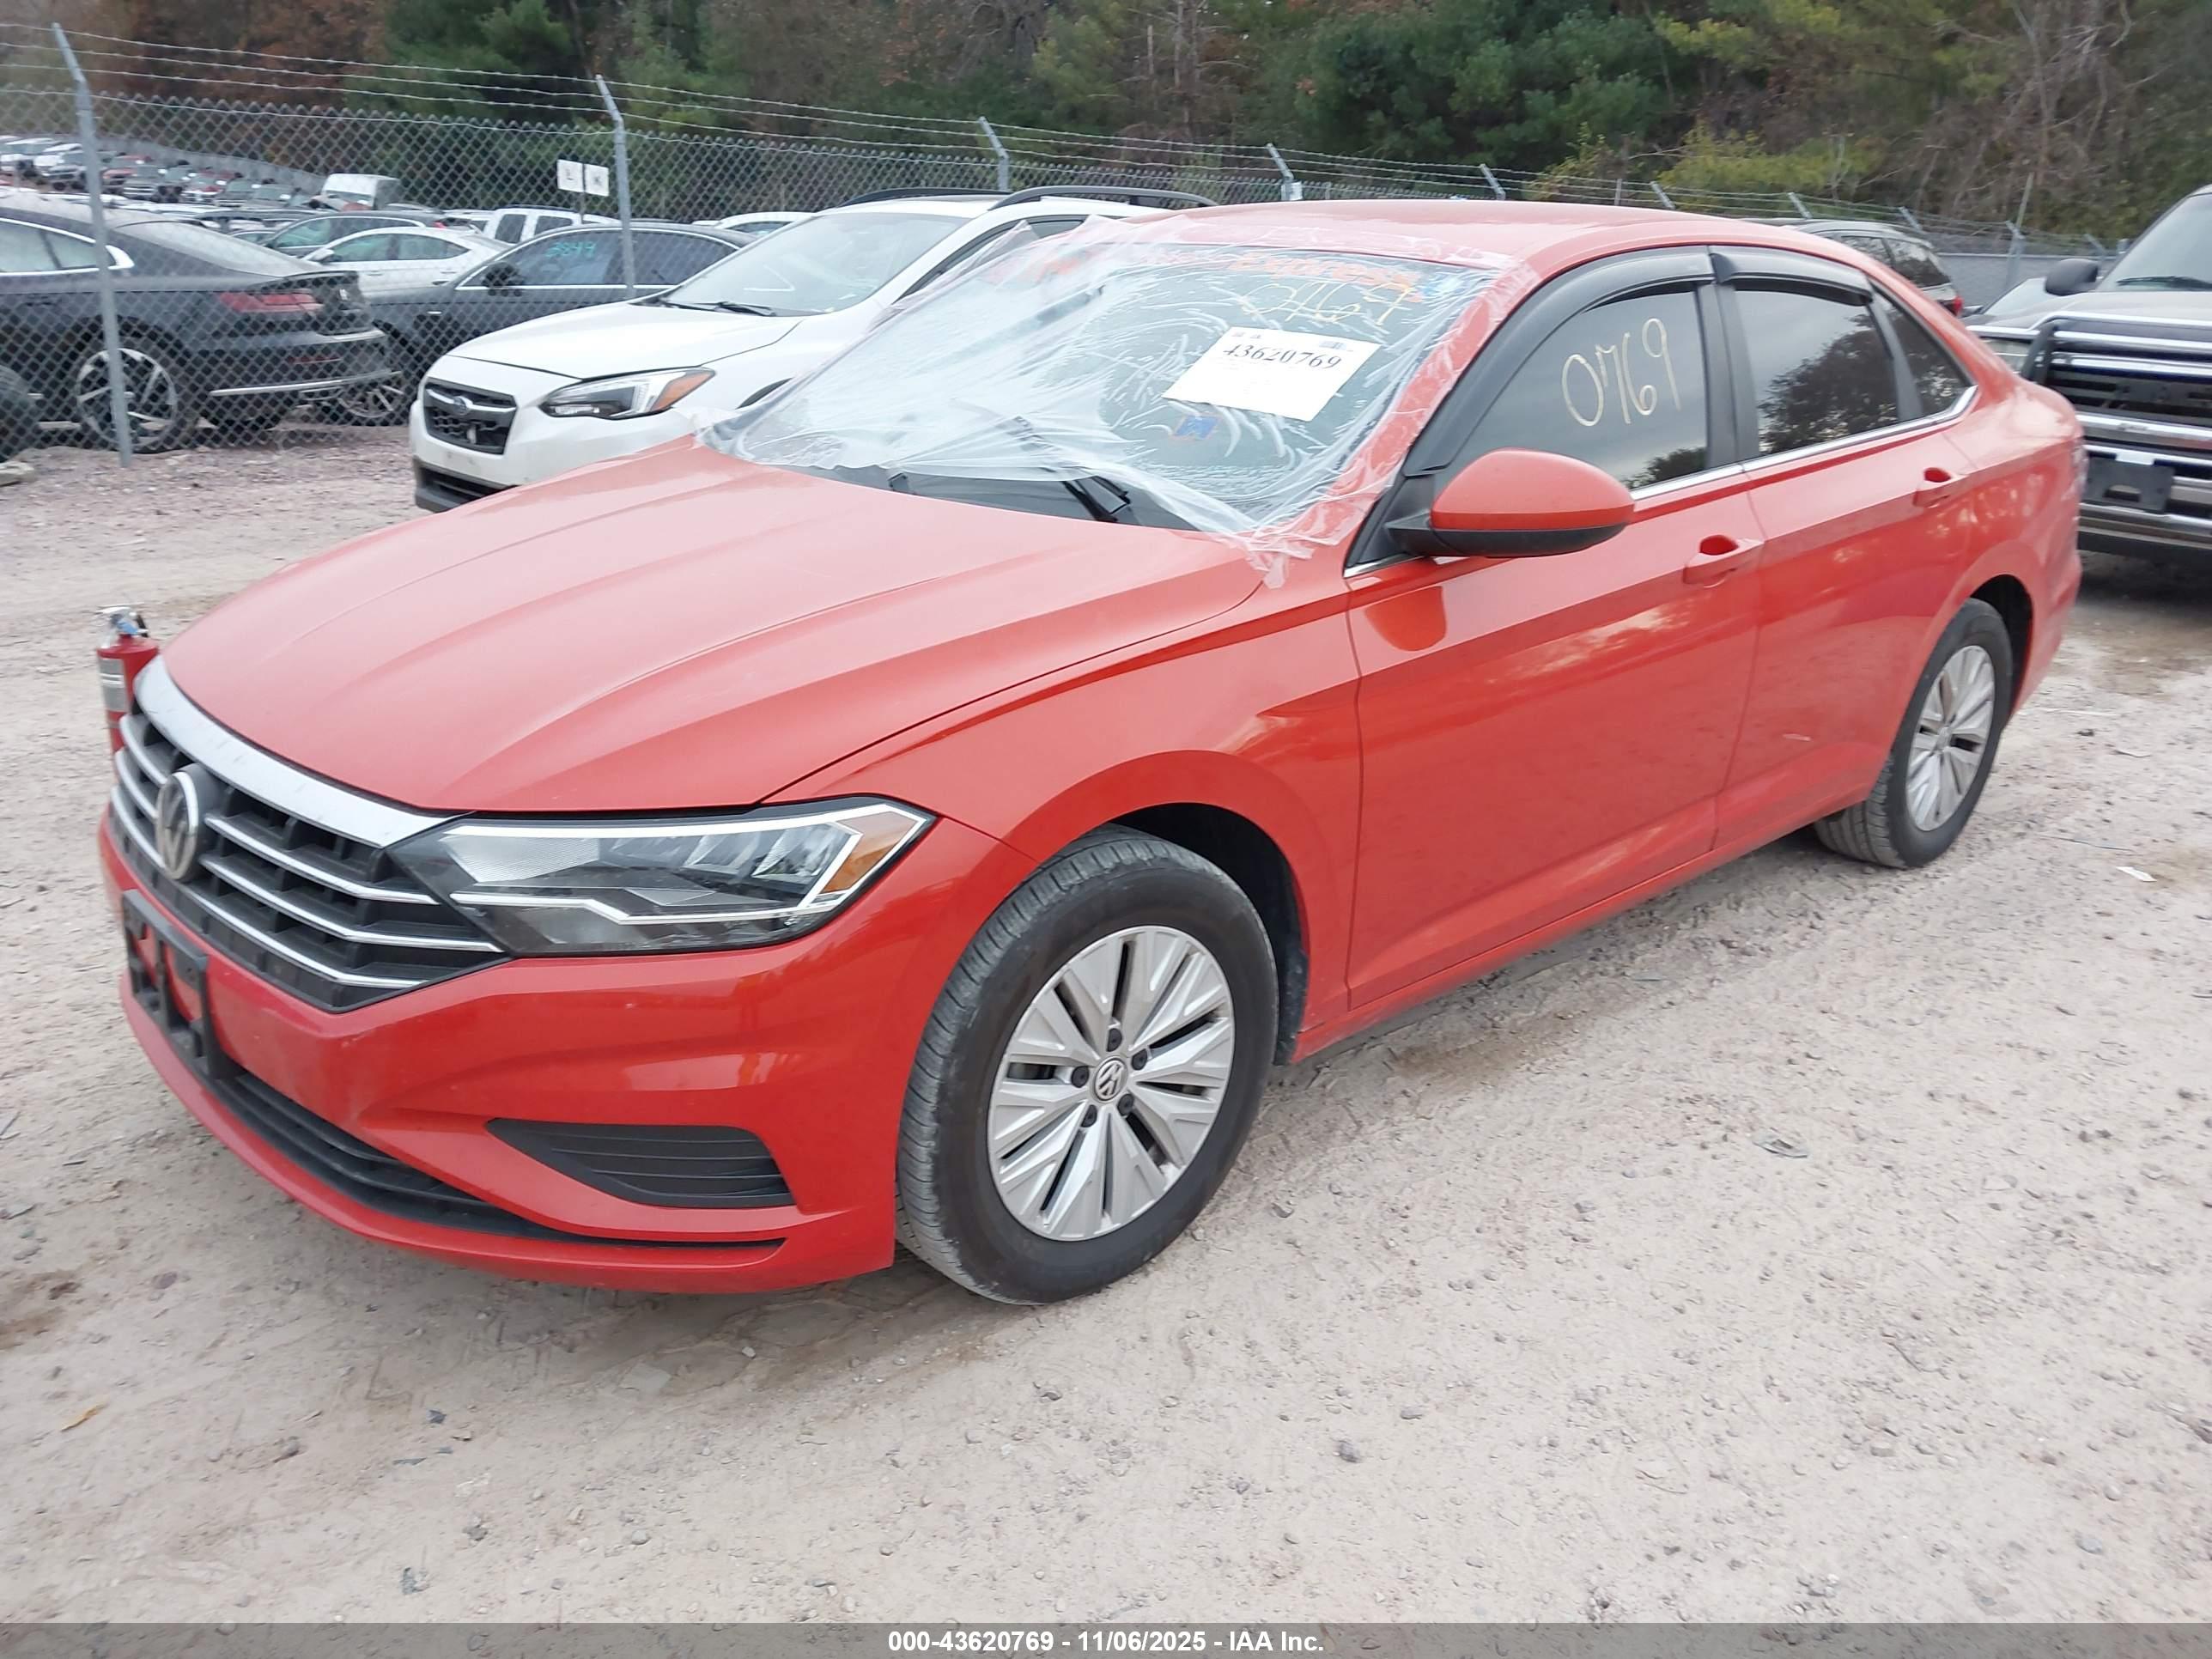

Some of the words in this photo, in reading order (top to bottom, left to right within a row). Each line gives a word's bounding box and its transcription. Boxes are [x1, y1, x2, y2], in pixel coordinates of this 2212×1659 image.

[1241, 280, 1415, 326] 0769
[1223, 343, 1343, 369] 43620769
[1561, 317, 1681, 427] 0769
